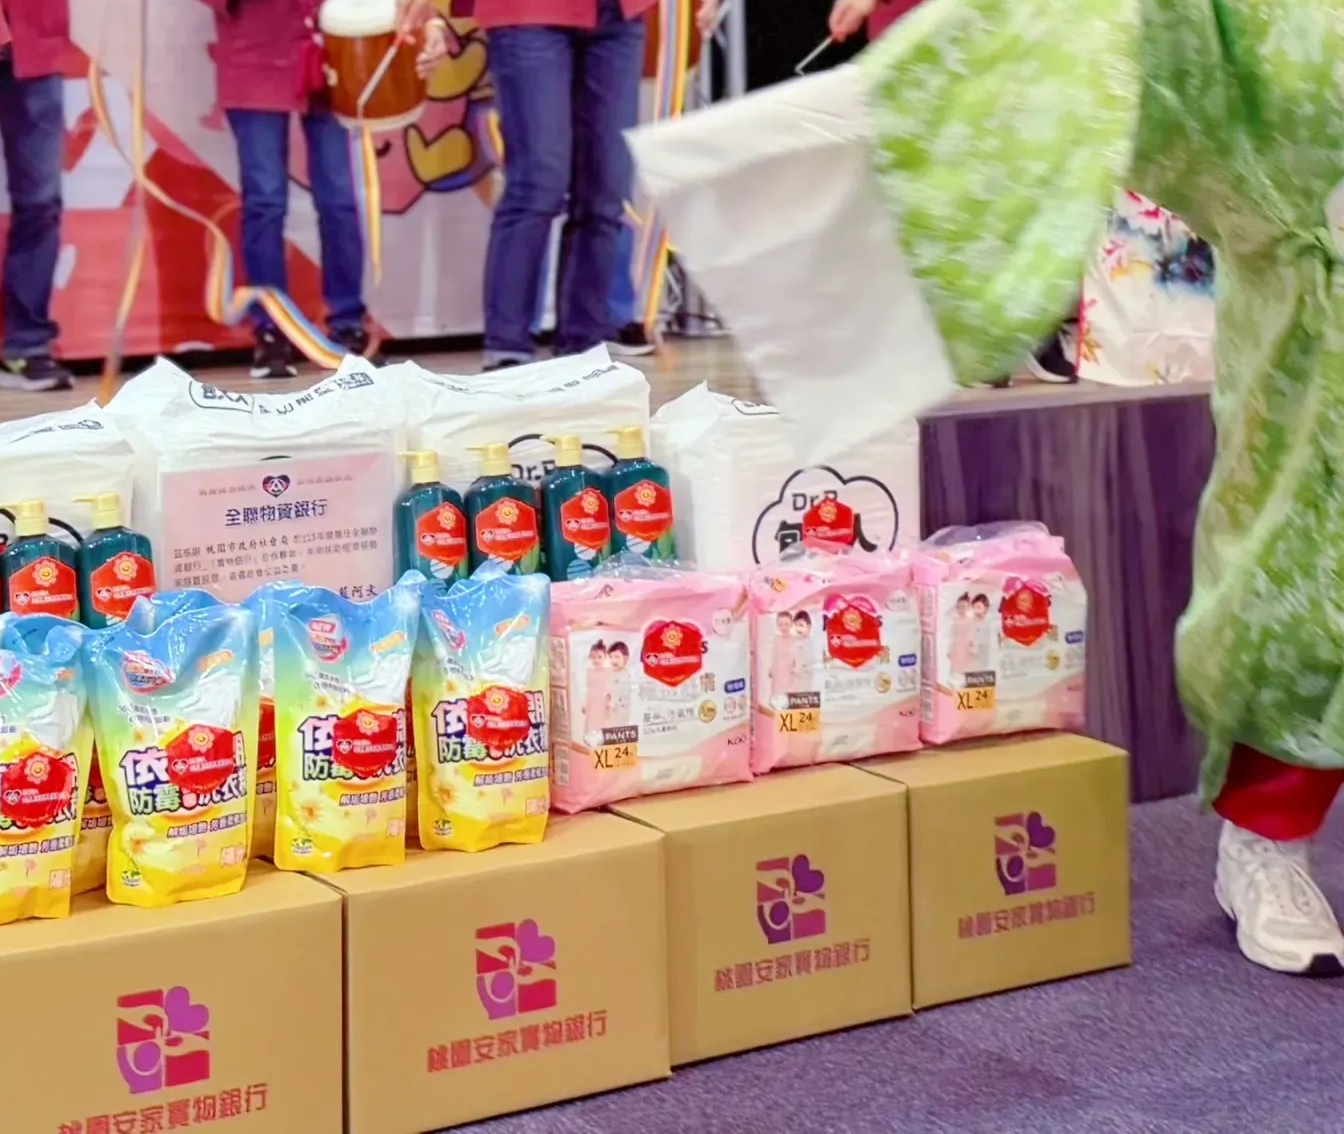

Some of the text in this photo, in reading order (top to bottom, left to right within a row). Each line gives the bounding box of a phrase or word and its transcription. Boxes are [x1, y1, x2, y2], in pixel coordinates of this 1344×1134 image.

[225, 498, 327, 527] 全聯物資銀行
[957, 690, 989, 710] XL 24
[780, 712, 813, 733] XL 24
[604, 729, 638, 742] PANTS
[594, 747, 630, 770] XL 24
[714, 938, 870, 992] 桃園安家實物銀行
[427, 1009, 608, 1073] 桃園安家實物銀行
